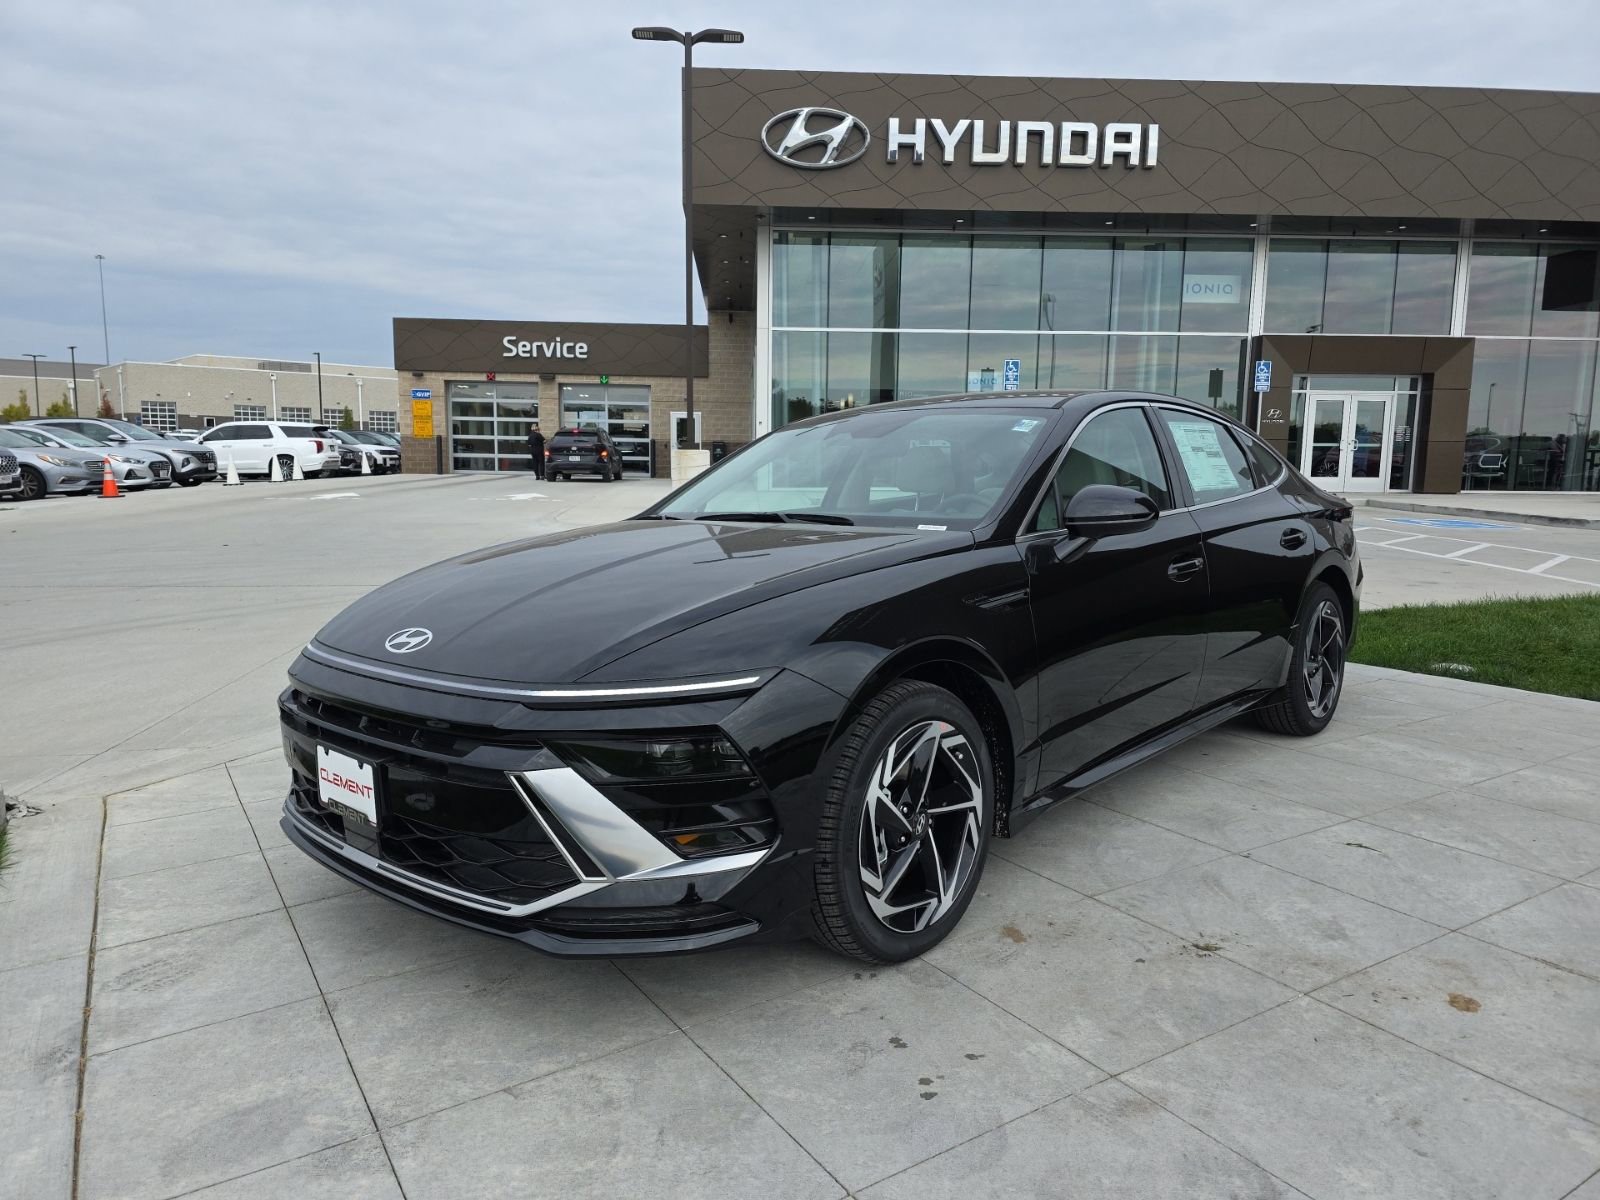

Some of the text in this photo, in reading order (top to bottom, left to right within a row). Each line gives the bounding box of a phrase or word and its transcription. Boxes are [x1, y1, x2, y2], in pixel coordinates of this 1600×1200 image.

[887, 117, 1159, 168] HYUNDAI
[1186, 283, 1233, 294] IONIQ
[502, 336, 588, 358] Service
[320, 767, 373, 798] CLEMENT
[328, 800, 365, 823] CLEMENT
